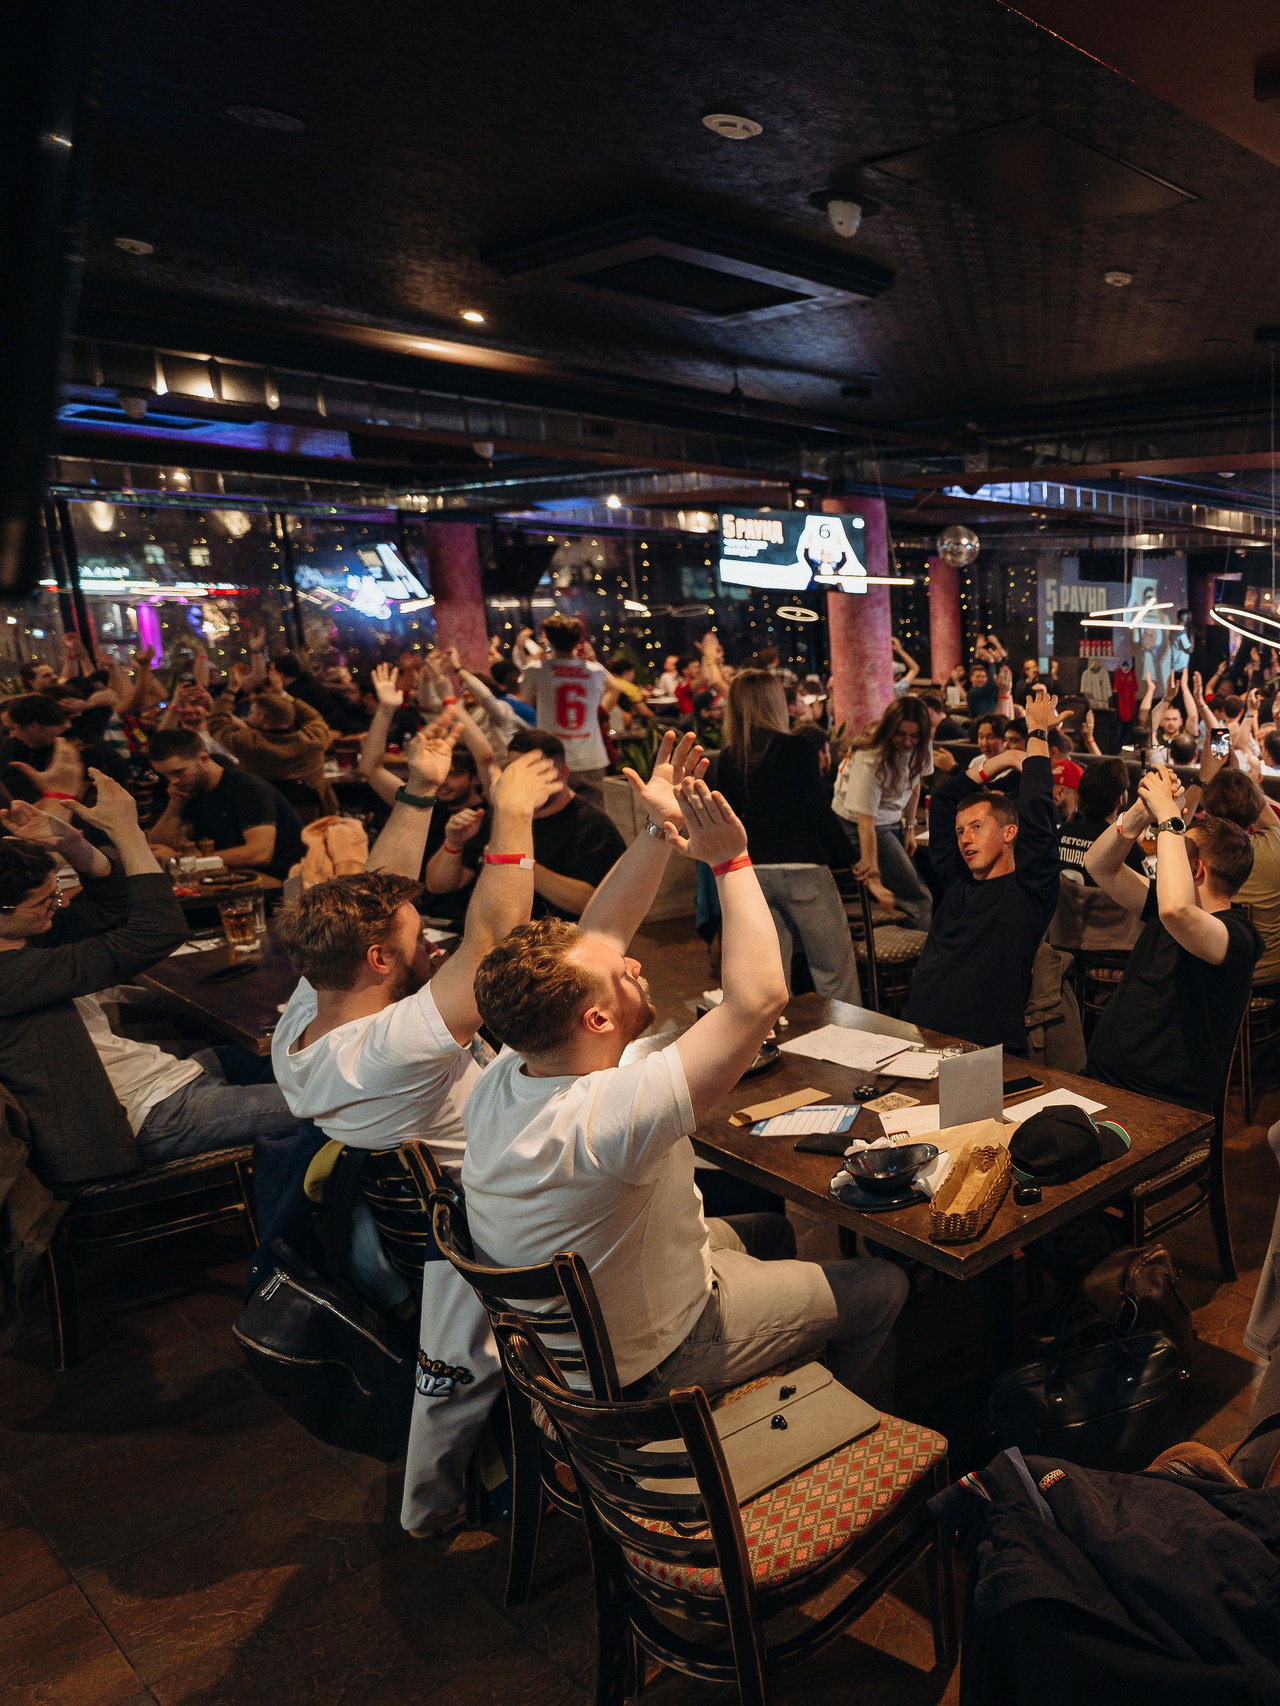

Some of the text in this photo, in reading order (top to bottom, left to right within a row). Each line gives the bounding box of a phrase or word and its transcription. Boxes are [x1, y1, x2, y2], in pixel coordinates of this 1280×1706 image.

[722, 513, 736, 539] 5
[818, 523, 831, 539] 6
[1045, 578, 1058, 617] 5
[556, 682, 588, 731] 6
[1060, 835, 1094, 849] БЕТСИТ
